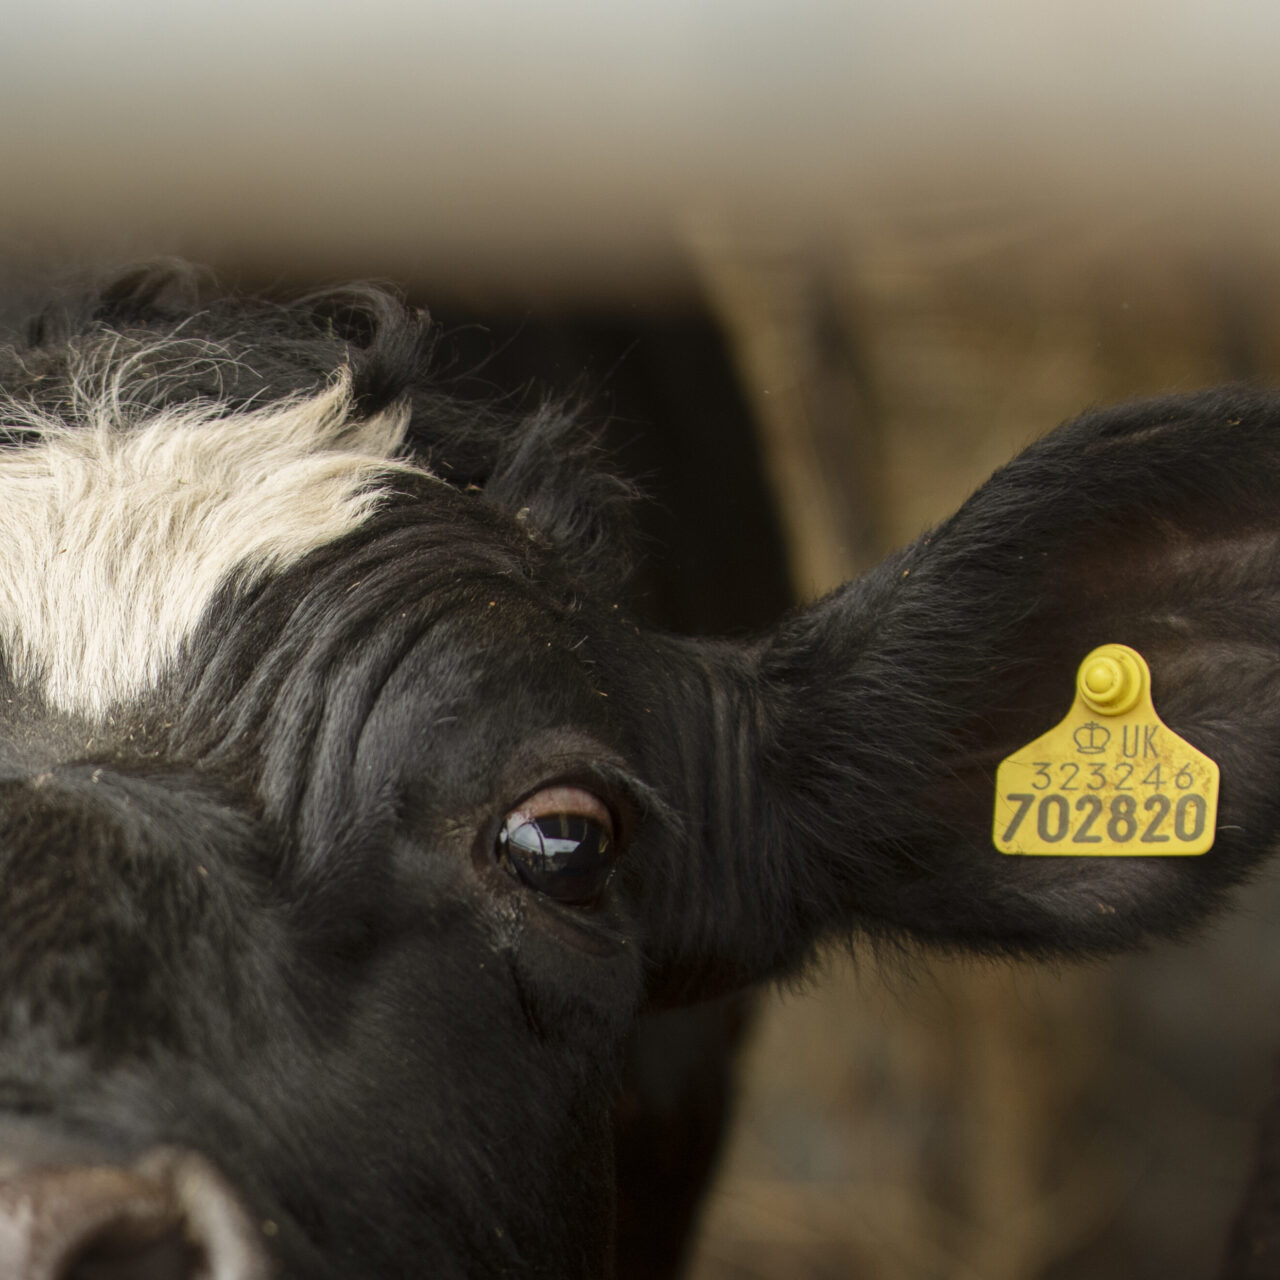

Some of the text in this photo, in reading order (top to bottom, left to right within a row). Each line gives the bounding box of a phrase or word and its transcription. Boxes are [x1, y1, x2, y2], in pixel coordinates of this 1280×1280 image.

[1122, 724, 1159, 759] UK
[1031, 762, 1194, 791] 323246
[1001, 793, 1207, 844] 702820
